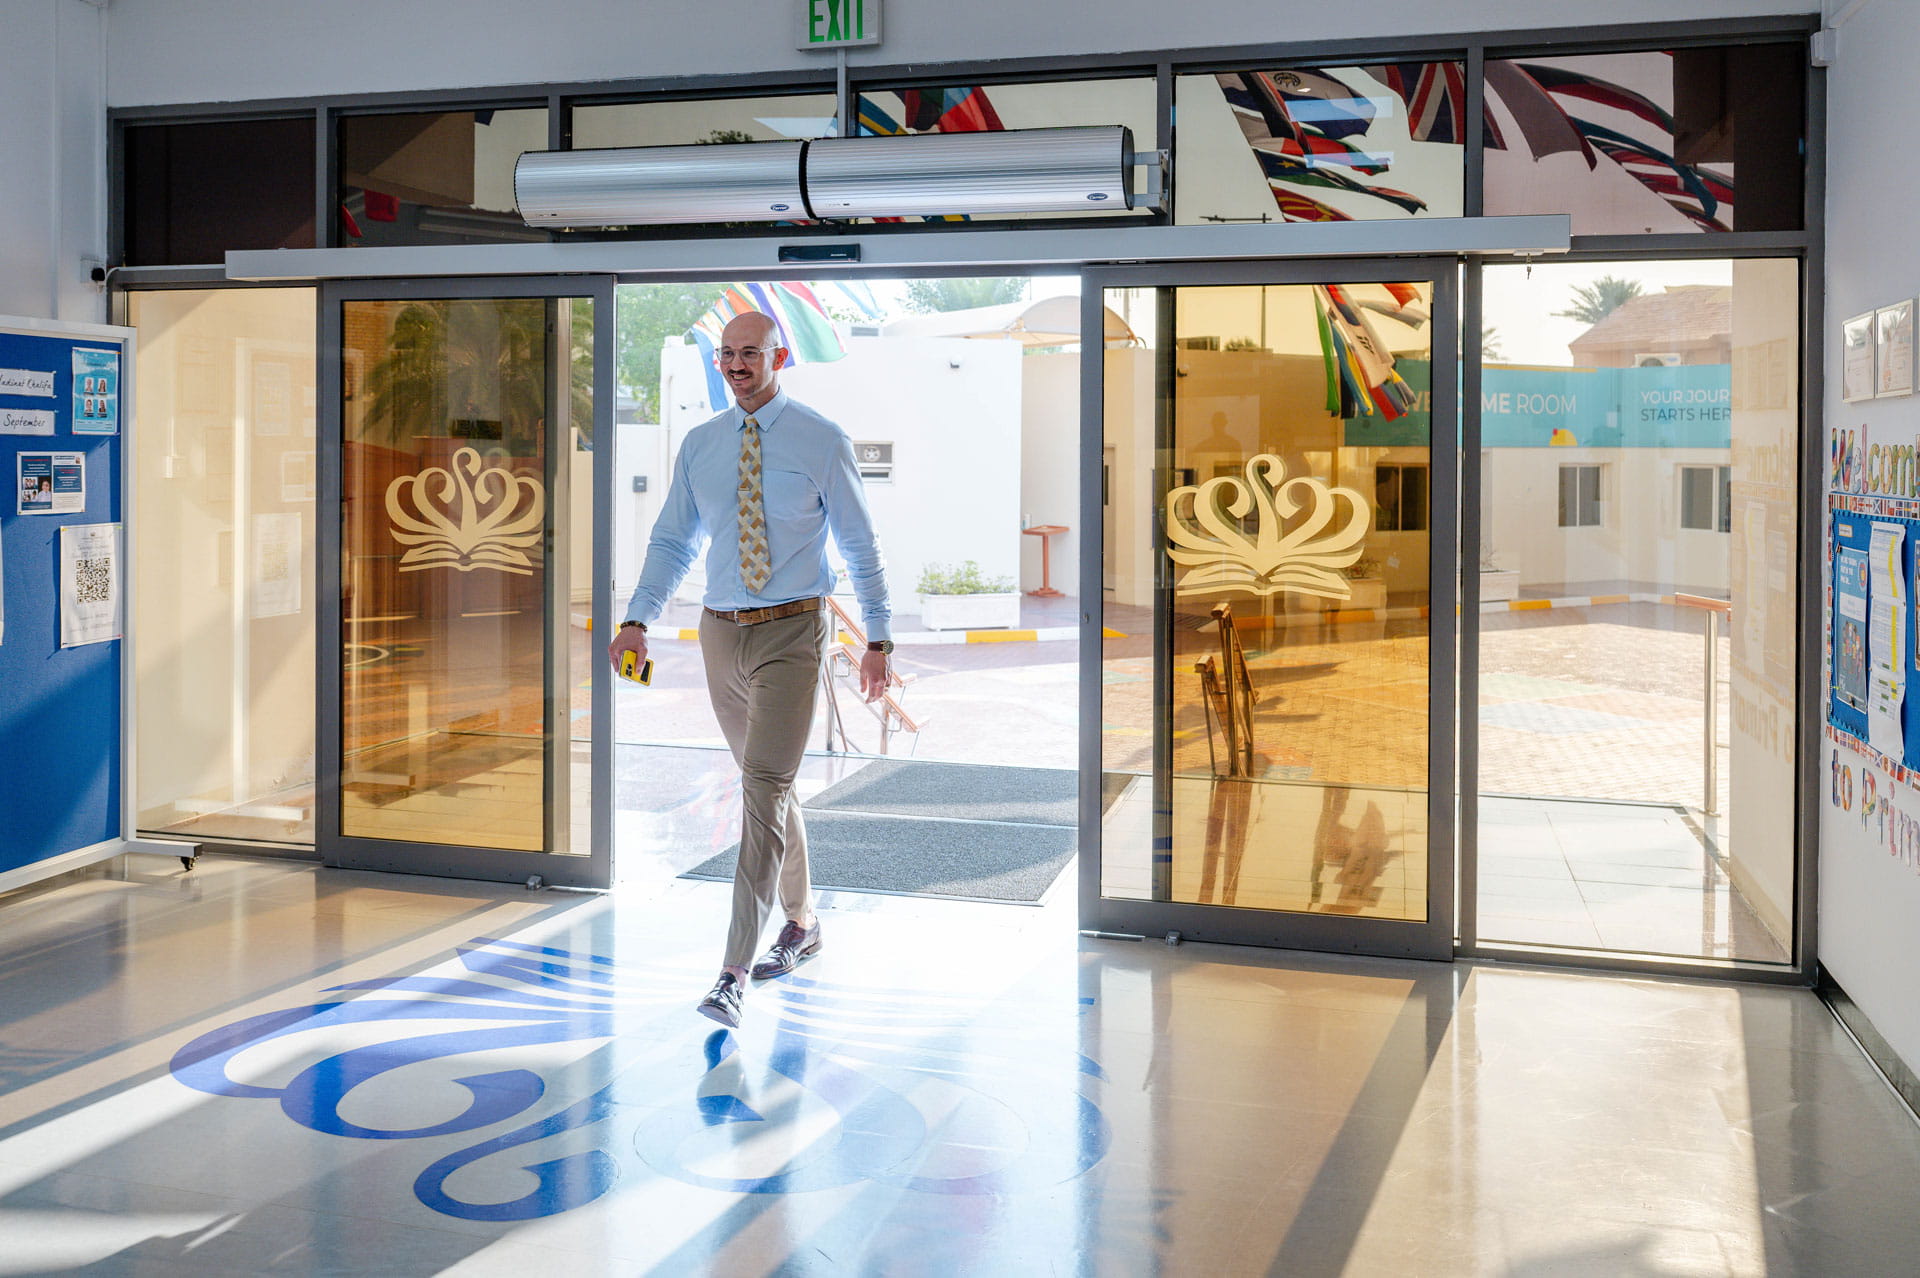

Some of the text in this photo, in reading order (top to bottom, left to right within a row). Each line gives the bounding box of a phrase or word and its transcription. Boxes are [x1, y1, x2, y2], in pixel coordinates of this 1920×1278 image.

[809, 0, 863, 43] EXIT
[1516, 393, 1577, 415] ROOM
[1640, 389, 1730, 404] YOUR JOUR
[3, 413, 46, 430] September
[1641, 407, 1696, 422] STARTS
[1832, 748, 1853, 812] to
